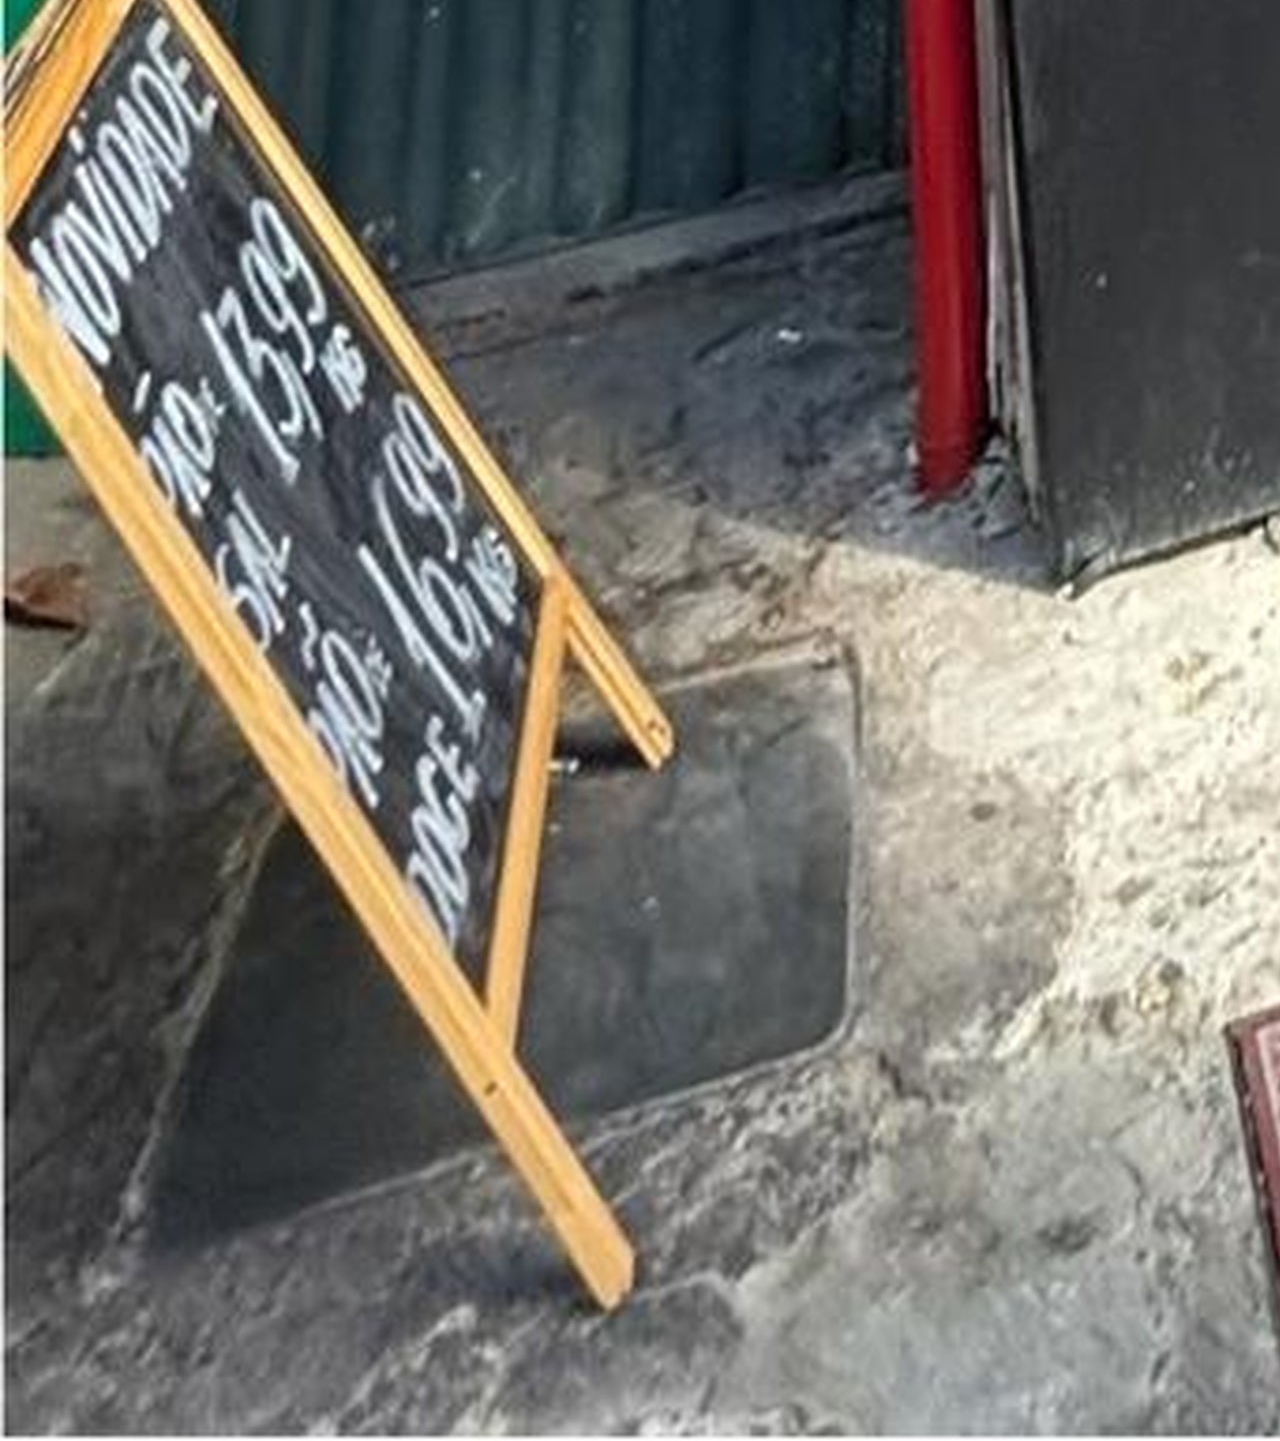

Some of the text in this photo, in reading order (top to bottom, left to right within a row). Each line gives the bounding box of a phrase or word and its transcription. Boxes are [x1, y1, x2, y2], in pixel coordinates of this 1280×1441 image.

[29, 17, 218, 367] NOVIDADE
[200, 197, 328, 484] 13,99
[214, 488, 291, 659] SAL
[358, 391, 518, 740] 16,99 KG
[406, 714, 480, 944] DOCE
